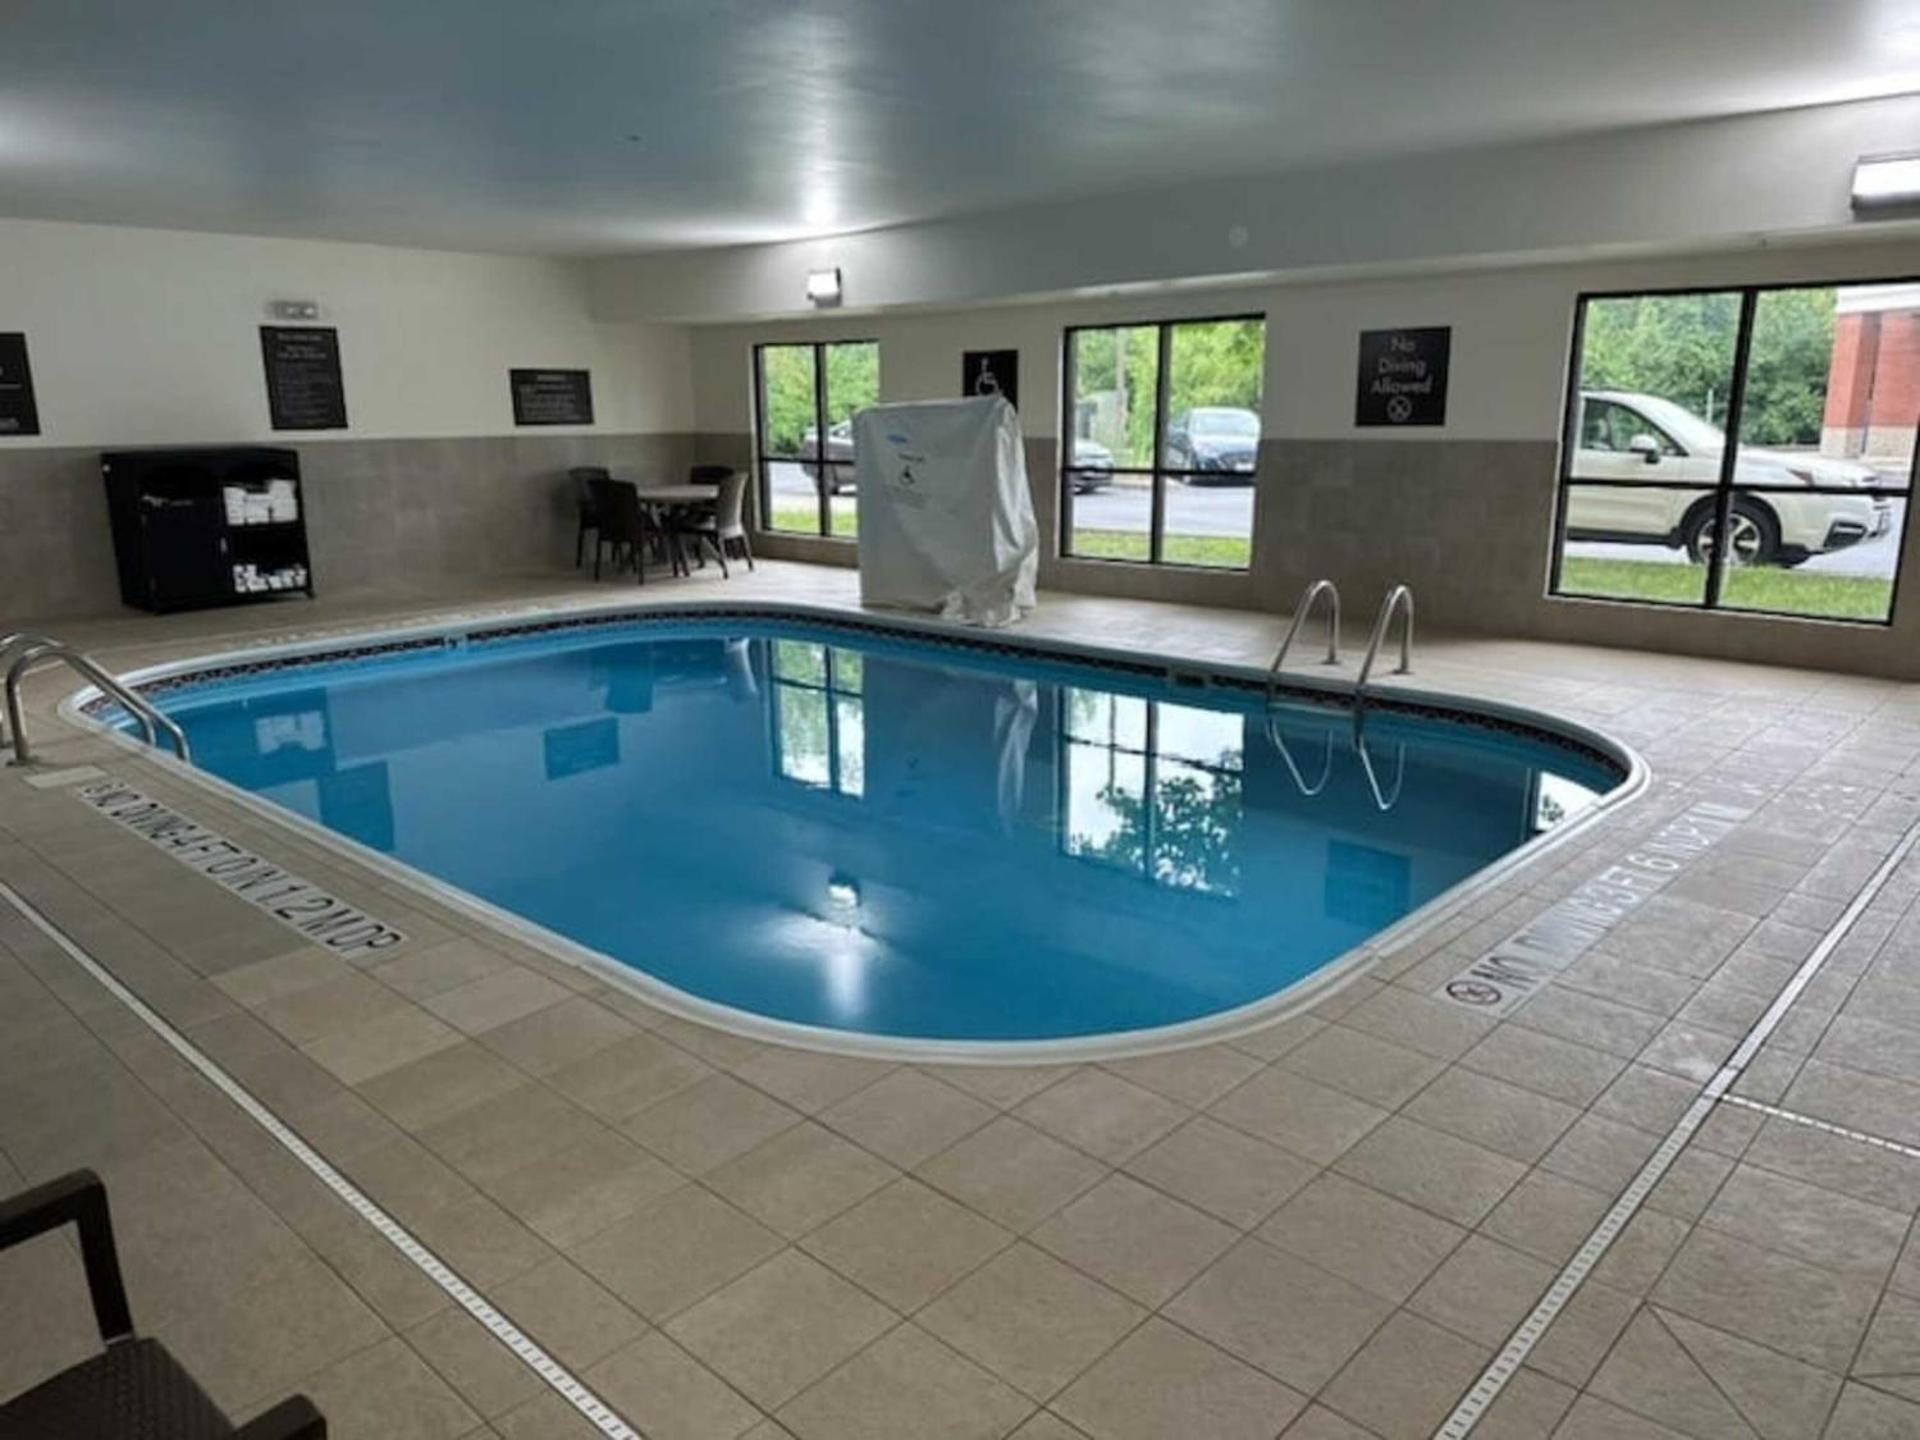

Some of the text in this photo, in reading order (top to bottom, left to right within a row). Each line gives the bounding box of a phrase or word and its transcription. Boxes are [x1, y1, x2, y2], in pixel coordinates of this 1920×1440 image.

[1390, 335, 1416, 352] No
[1370, 374, 1434, 395] Allowed
[1468, 955, 1556, 993] NO
